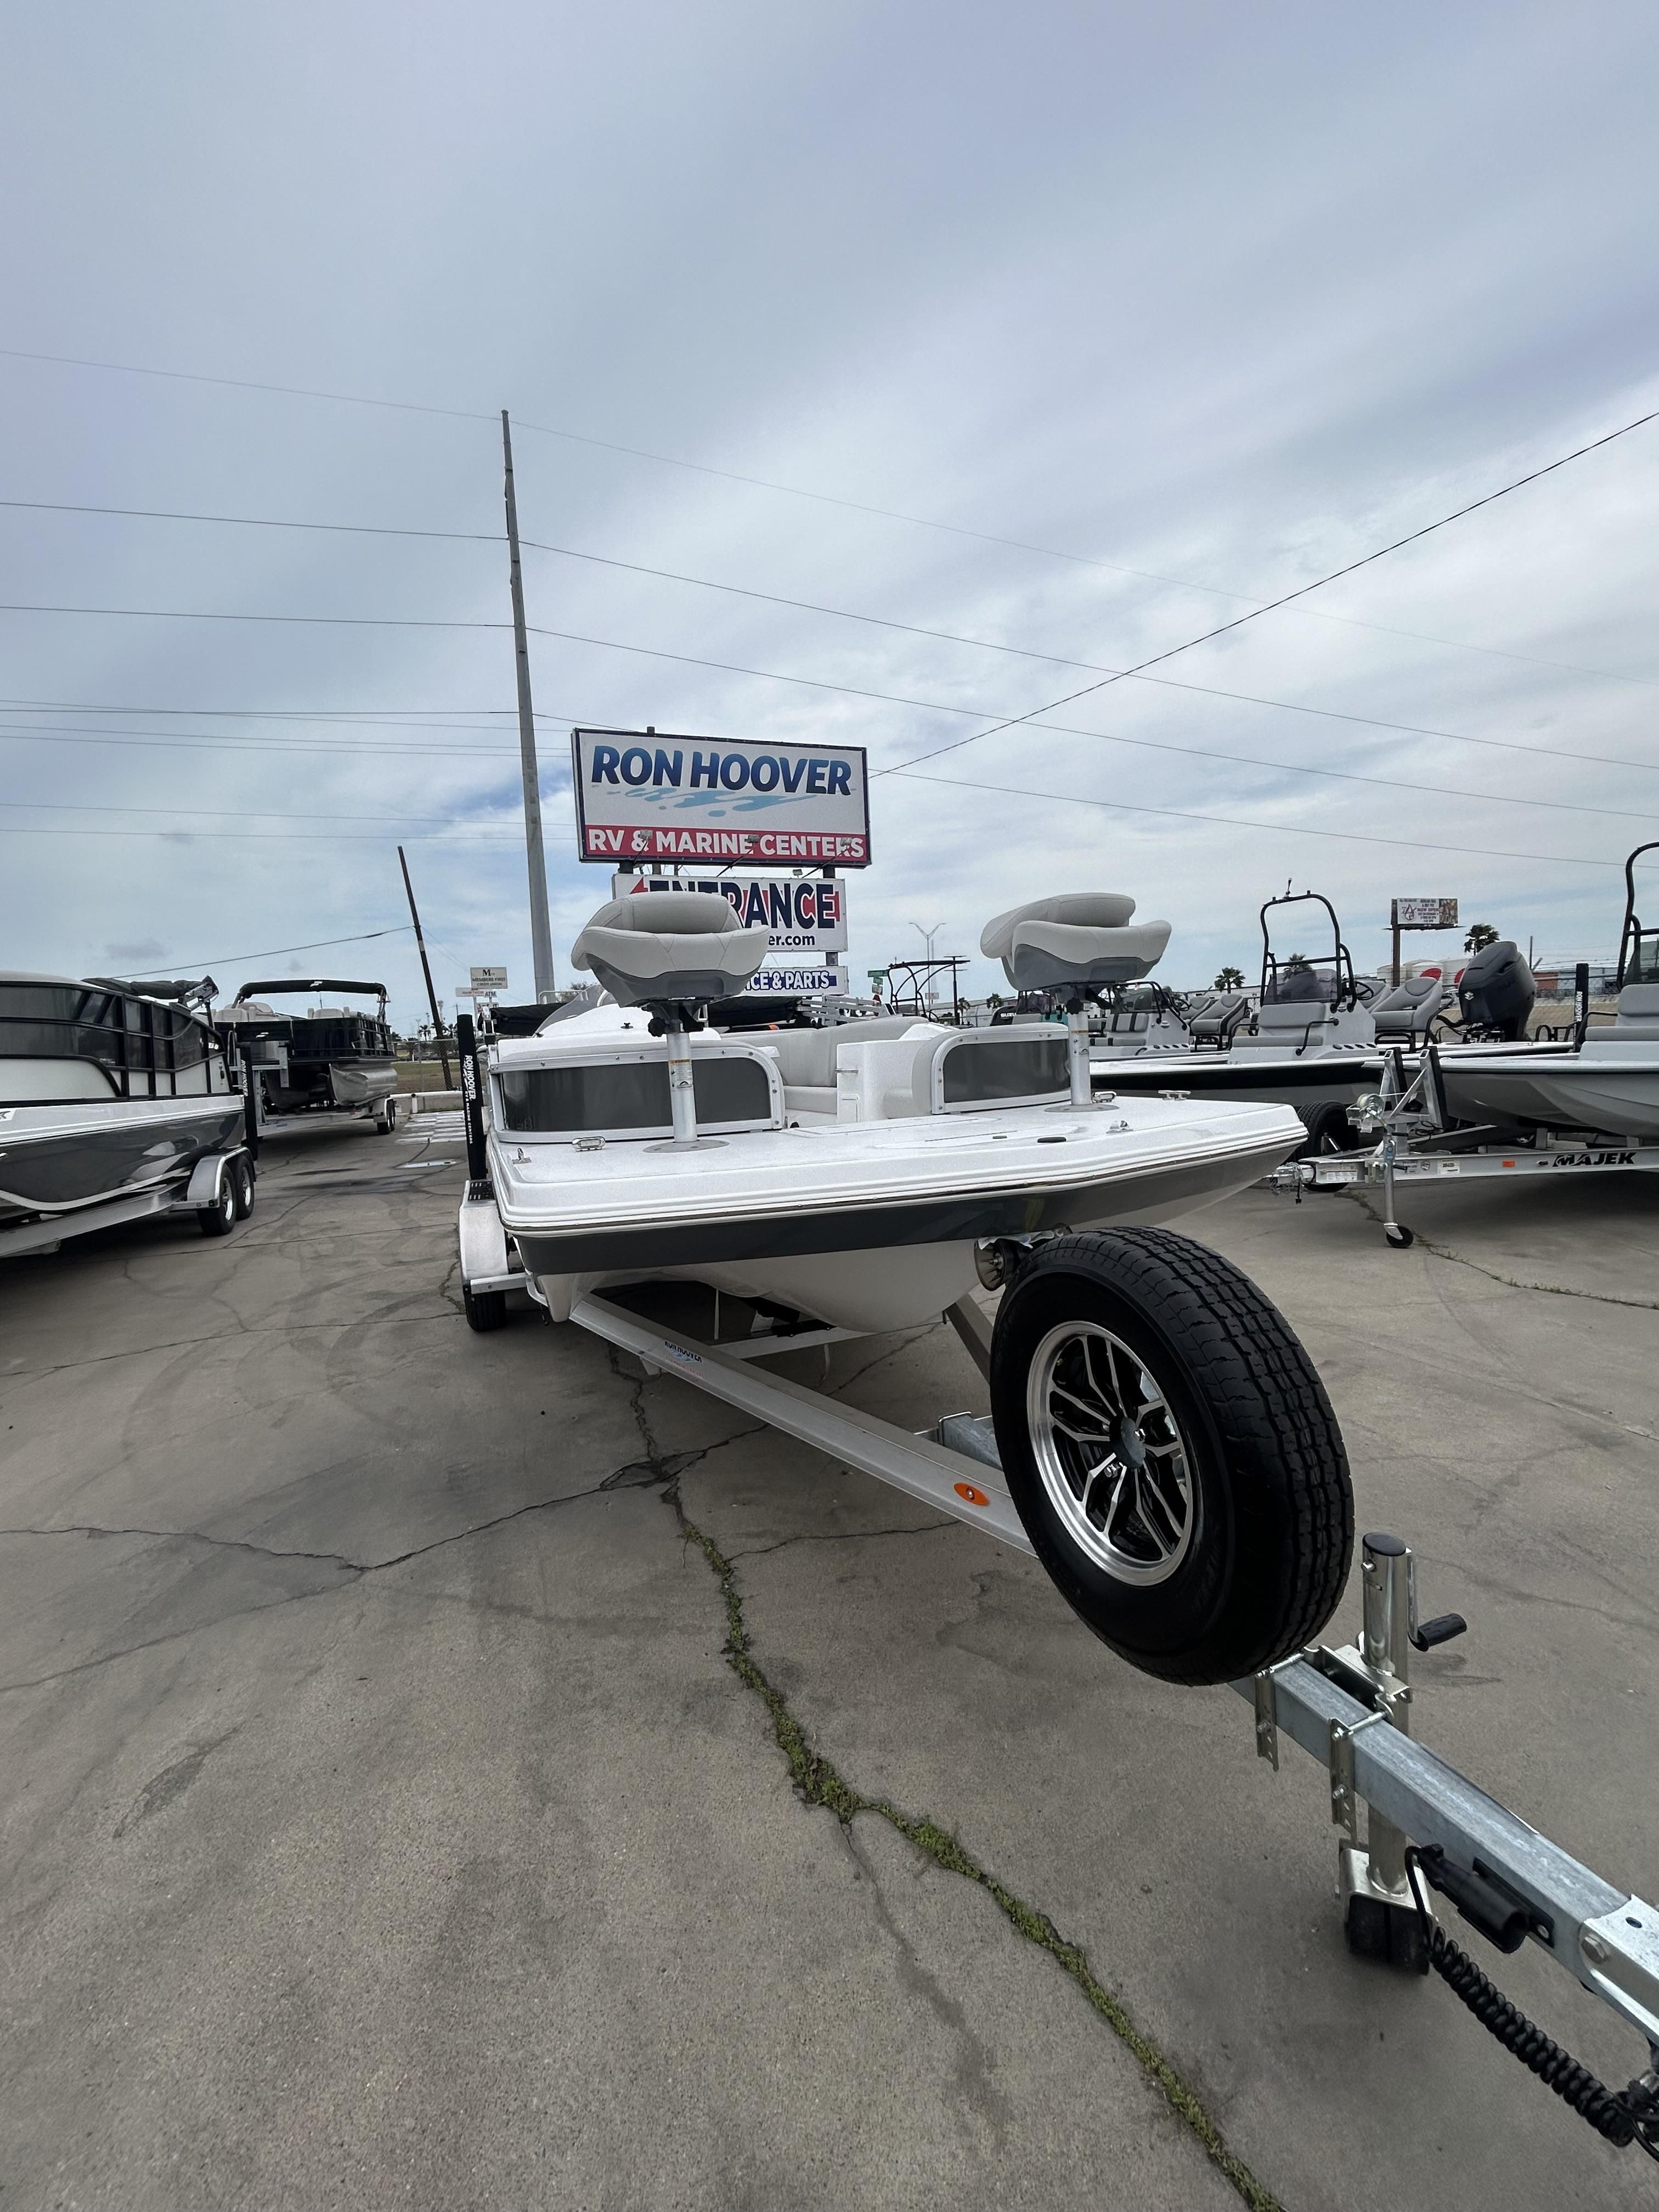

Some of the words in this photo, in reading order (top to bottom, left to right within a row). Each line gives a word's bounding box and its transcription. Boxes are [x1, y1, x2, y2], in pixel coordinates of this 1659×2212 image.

[591, 745, 683, 787] RON
[690, 751, 851, 795] HOOVER
[588, 829, 624, 851] RV
[631, 830, 650, 851] &
[656, 831, 754, 854] MARINE
[760, 834, 864, 857] CENTERS
[650, 880, 835, 929] RANCE
[771, 971, 783, 990] &
[784, 970, 830, 990] PARTS
[465, 1055, 474, 1070] RON
[467, 1070, 476, 1101] HOOVER
[1553, 1152, 1637, 1167] MAJEK
